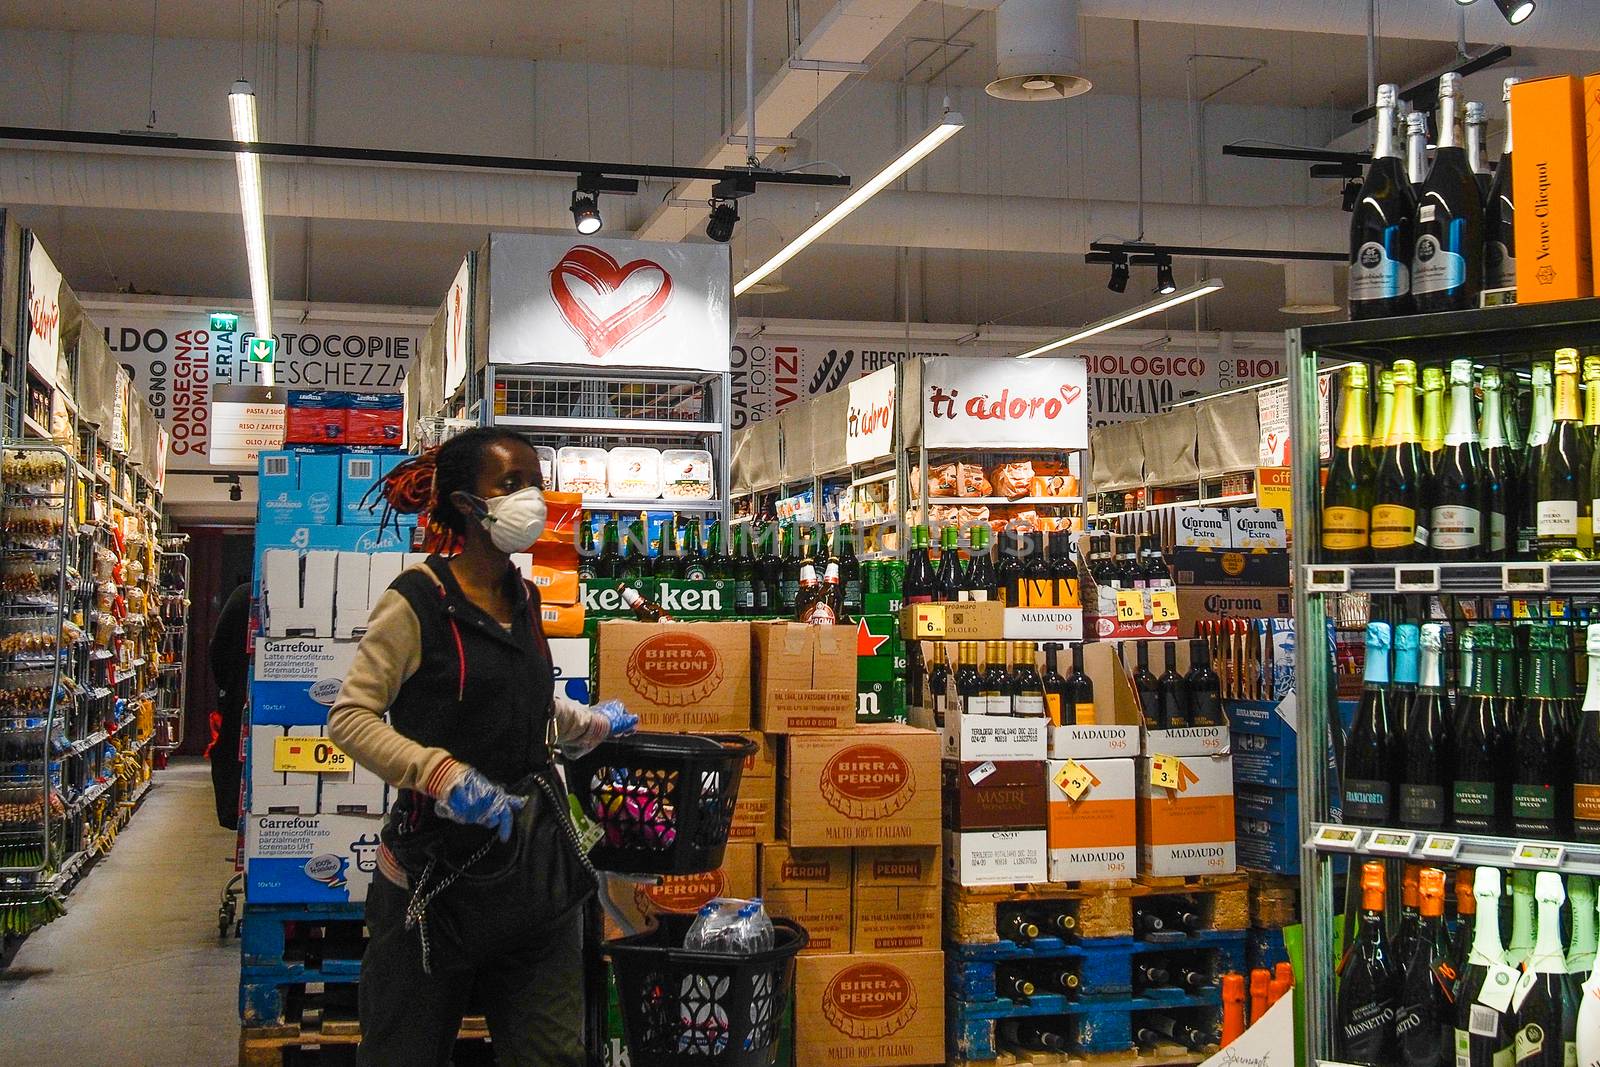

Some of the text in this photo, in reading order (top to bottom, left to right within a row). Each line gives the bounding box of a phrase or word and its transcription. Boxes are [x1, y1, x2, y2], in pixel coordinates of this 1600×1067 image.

[1535, 162, 1551, 260] Veuve Clicquot
[750, 346, 766, 394] FOTO
[171, 330, 192, 455] CONSEGNA
[191, 330, 209, 455] A DOMICILIO
[266, 391, 272, 399] 4
[1095, 378, 1173, 413] VEGANO
[930, 385, 957, 419] ti
[965, 388, 1062, 420] adoro
[1182, 516, 1222, 531] Corona
[1237, 518, 1277, 533] Corona
[1193, 529, 1215, 538] Extra
[1249, 530, 1270, 539] Extra
[578, 583, 632, 611] ke
[1204, 594, 1262, 616] Corona
[1021, 613, 1073, 622] MADAUDO
[1121, 608, 1133, 617] 10
[1161, 608, 1168, 617] 5
[264, 641, 324, 652] Carrefour
[645, 649, 706, 658] BIRRA
[645, 661, 709, 671] PERONI
[683, 713, 720, 725] ITALIANO
[1072, 730, 1126, 740] MADAUDO
[1165, 728, 1219, 739] MADAUDO
[1108, 740, 1127, 749] 1945
[838, 761, 899, 771] BIRRA
[838, 773, 900, 784] PERONI
[1161, 772, 1168, 782] 3
[259, 817, 319, 828] Carrefour
[260, 829, 330, 837] Latte microfiltrato
[825, 826, 851, 839] MALTO
[875, 825, 912, 838] ITALIANO
[1070, 852, 1125, 862] MADAUDO
[1171, 848, 1224, 859] MADAUDO
[785, 866, 827, 877] PERONI
[878, 864, 918, 874] PERONI
[1107, 863, 1125, 872] 1945
[652, 883, 716, 895] PERONI
[840, 980, 901, 990] BIRRA
[840, 992, 902, 1003] PERONI
[828, 1047, 854, 1058] MALTO
[878, 1046, 914, 1057] ITALIANO
